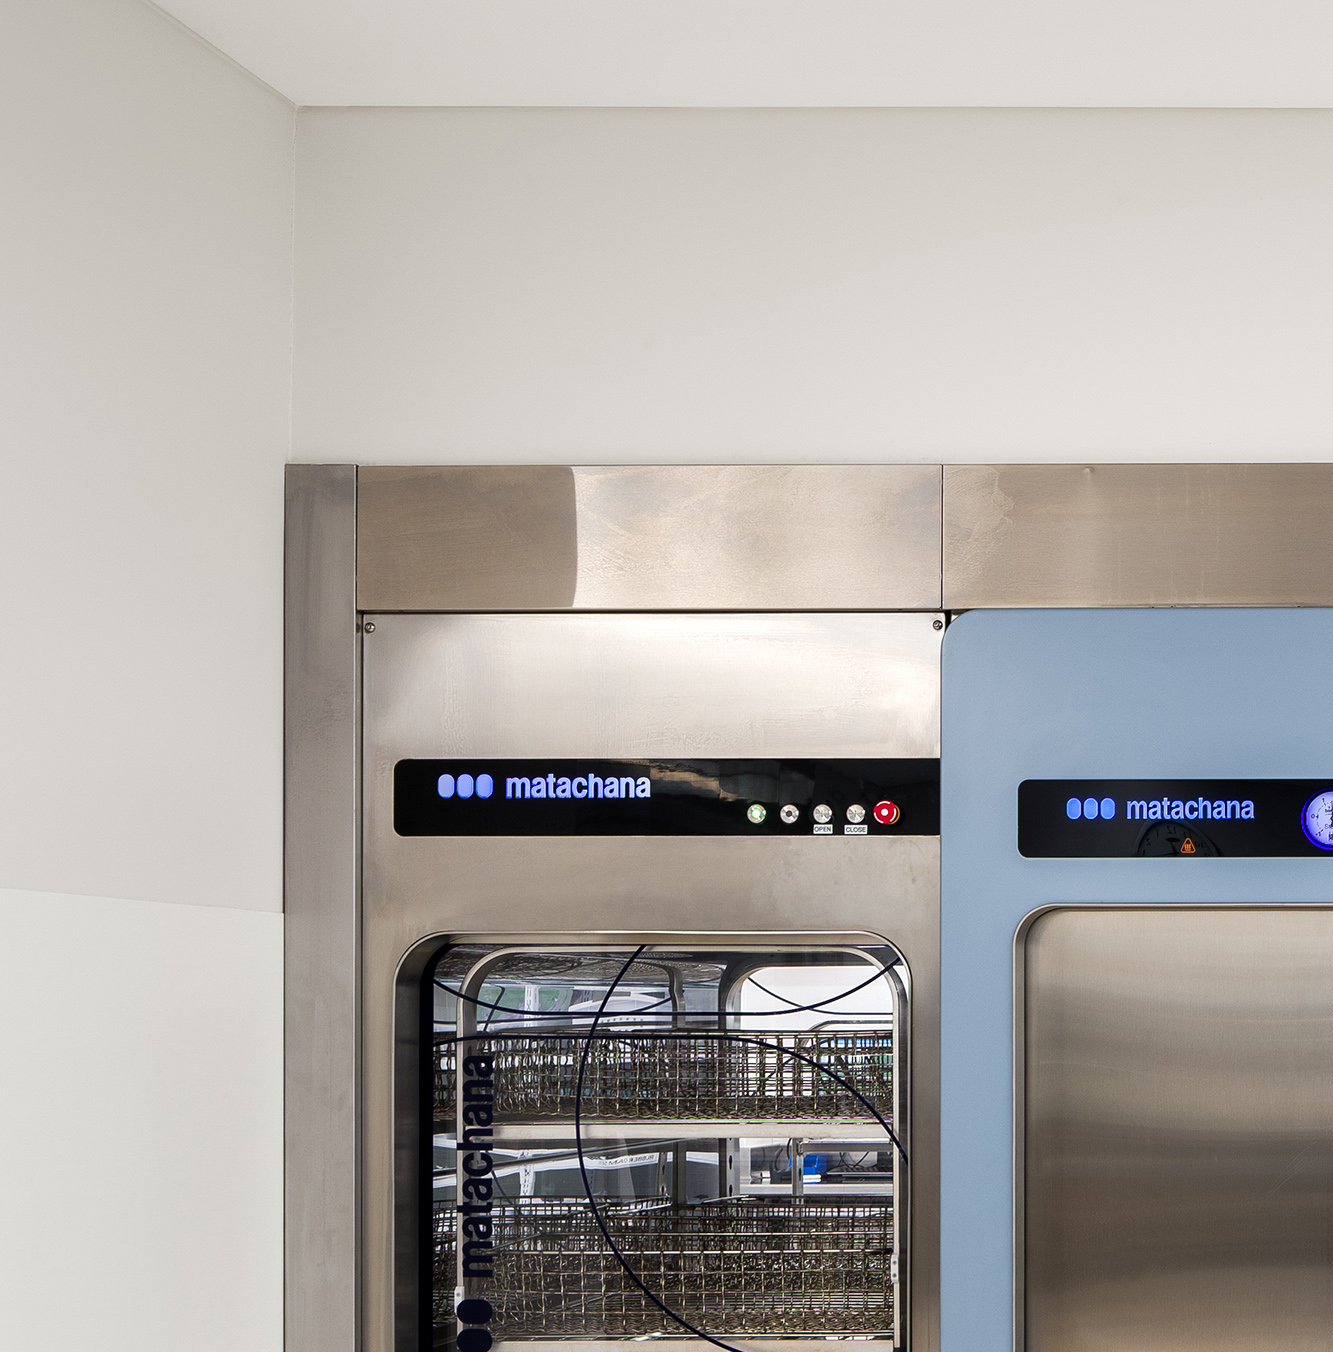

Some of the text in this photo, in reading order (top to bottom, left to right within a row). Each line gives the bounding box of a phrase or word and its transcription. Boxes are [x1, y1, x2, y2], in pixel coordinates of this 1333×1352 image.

[505, 772, 651, 798] matachana
[1126, 797, 1254, 819] matachana
[456, 1054, 494, 1278] matachana
